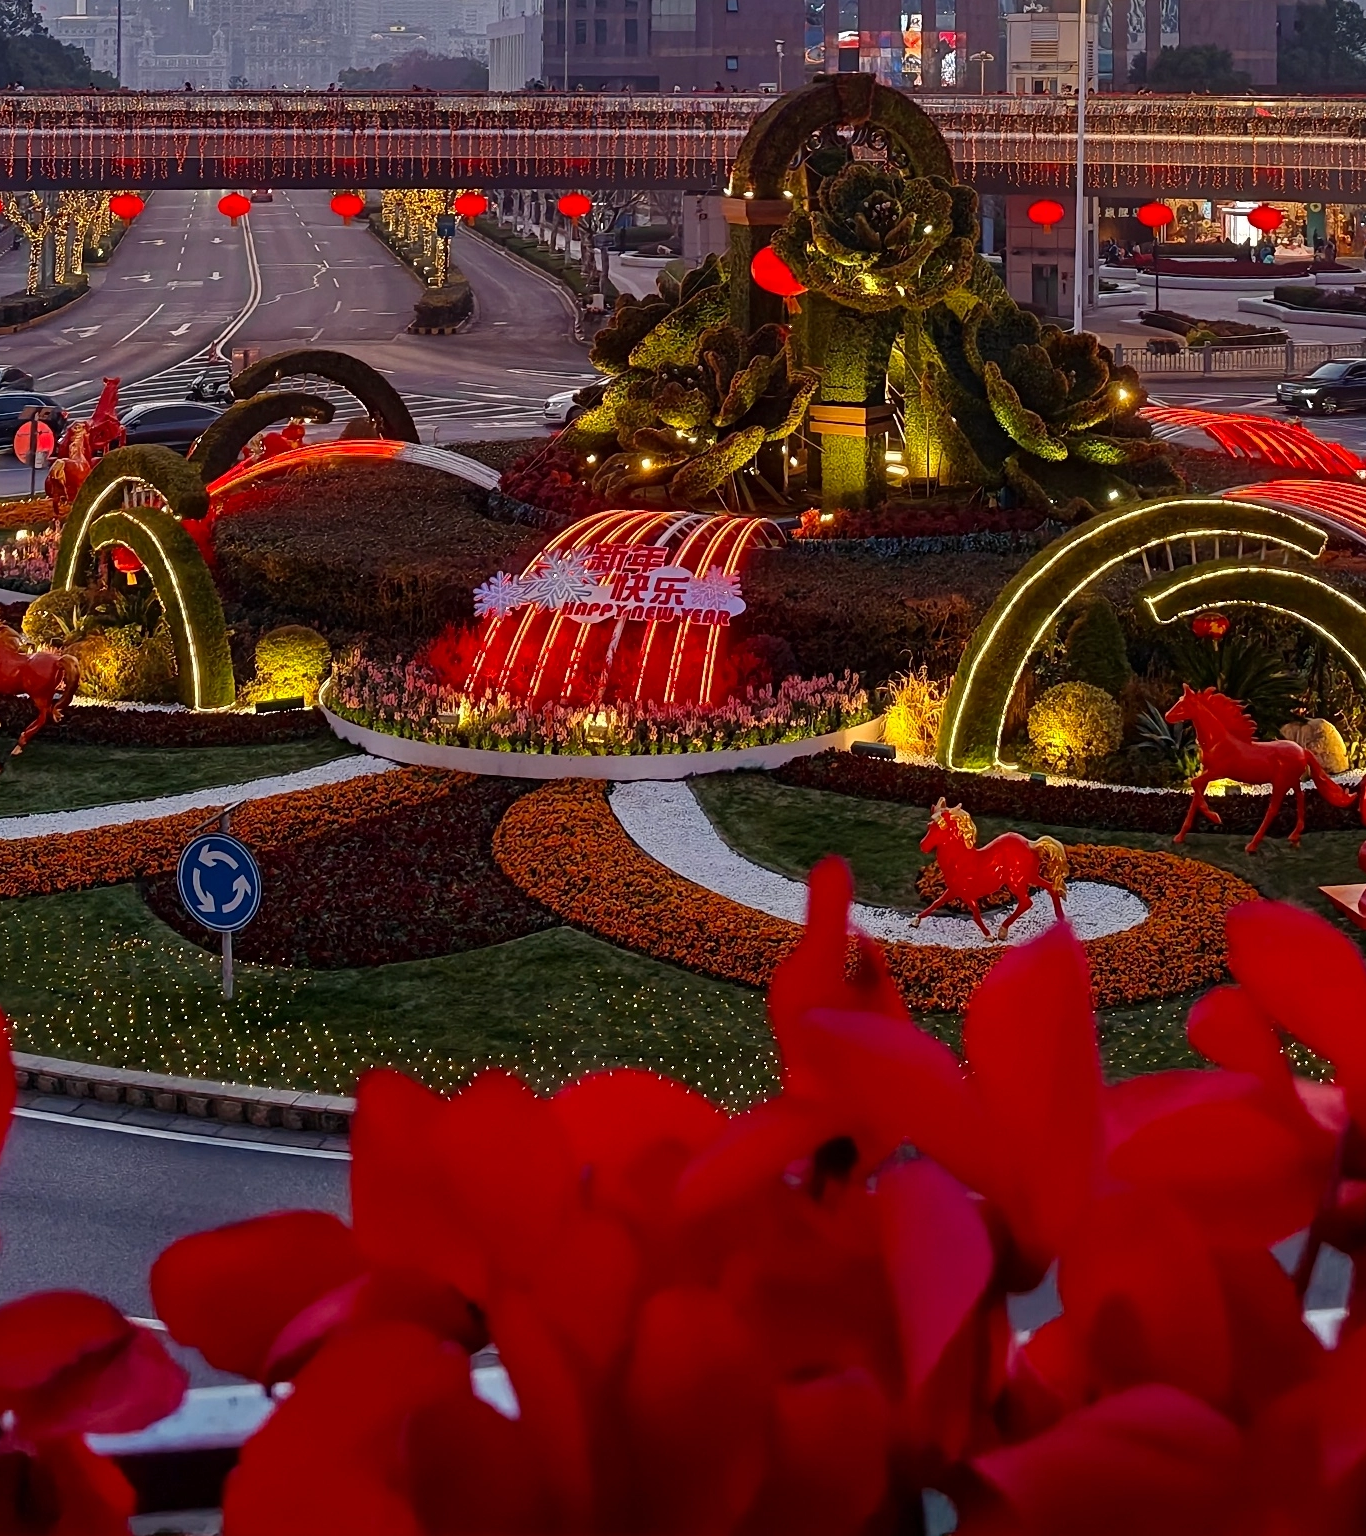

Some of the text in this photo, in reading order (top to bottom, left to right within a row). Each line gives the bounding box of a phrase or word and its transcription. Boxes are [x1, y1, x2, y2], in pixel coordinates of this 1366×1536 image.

[590, 543, 669, 574] 新年
[610, 573, 689, 606] 快乐
[561, 601, 627, 619] HAPPY
[680, 607, 732, 626] YEAR
